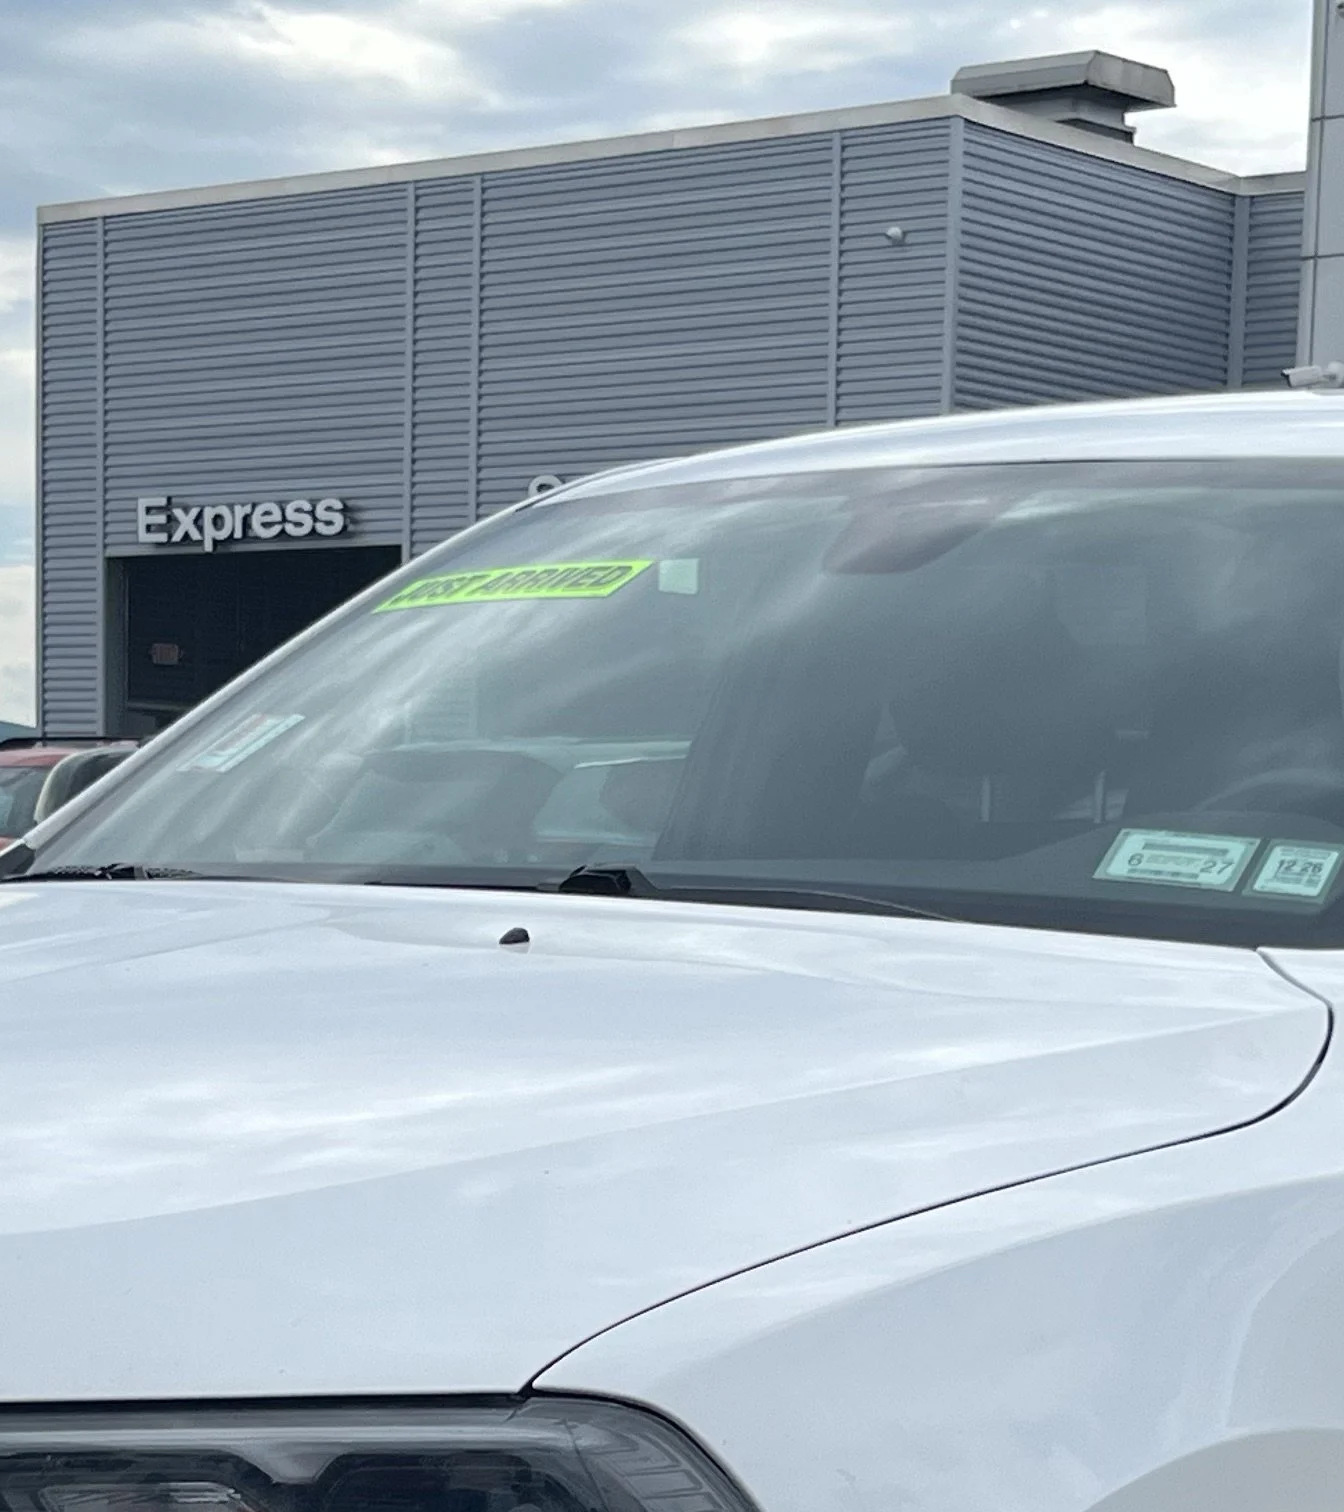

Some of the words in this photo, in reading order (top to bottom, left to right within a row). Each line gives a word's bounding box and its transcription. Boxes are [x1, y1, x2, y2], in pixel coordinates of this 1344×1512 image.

[136, 497, 345, 551] Express
[464, 565, 633, 597] ARRIVED
[1200, 859, 1234, 875] 27
